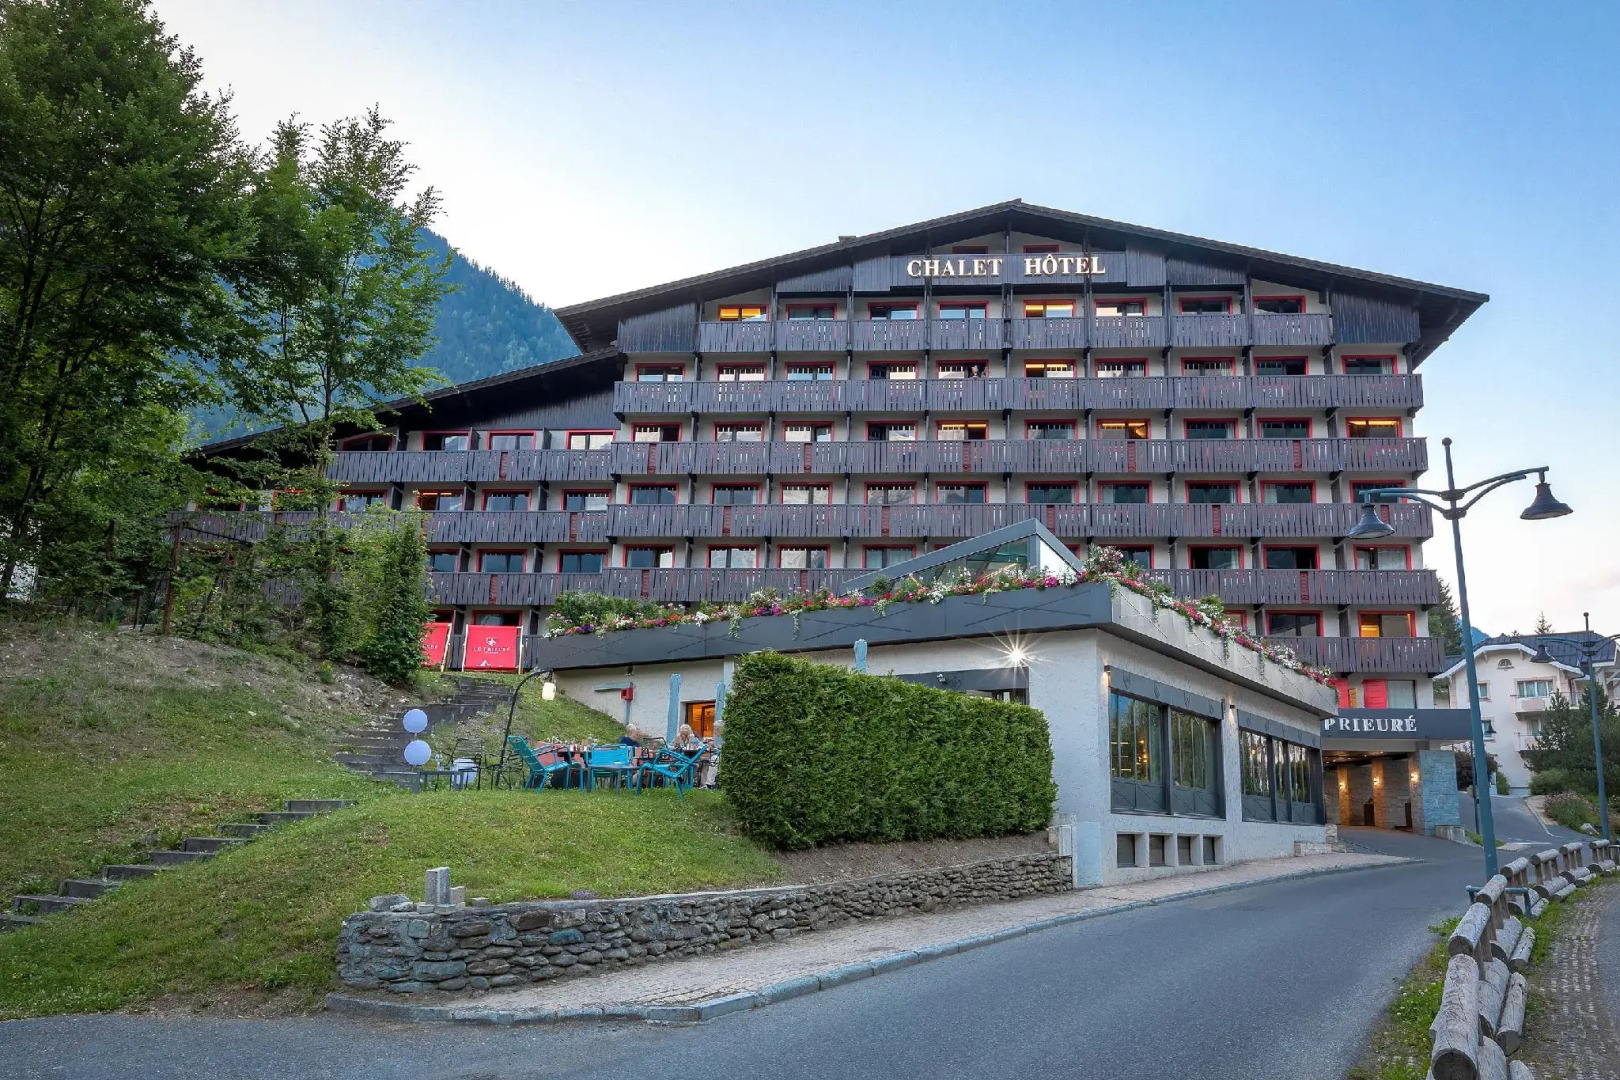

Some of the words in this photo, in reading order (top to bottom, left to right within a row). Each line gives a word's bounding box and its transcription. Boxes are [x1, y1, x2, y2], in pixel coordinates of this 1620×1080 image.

[906, 258, 1003, 277] CHALET
[1024, 253, 1106, 275] HÔTEL
[1324, 714, 1417, 732] PRIEURÉ
